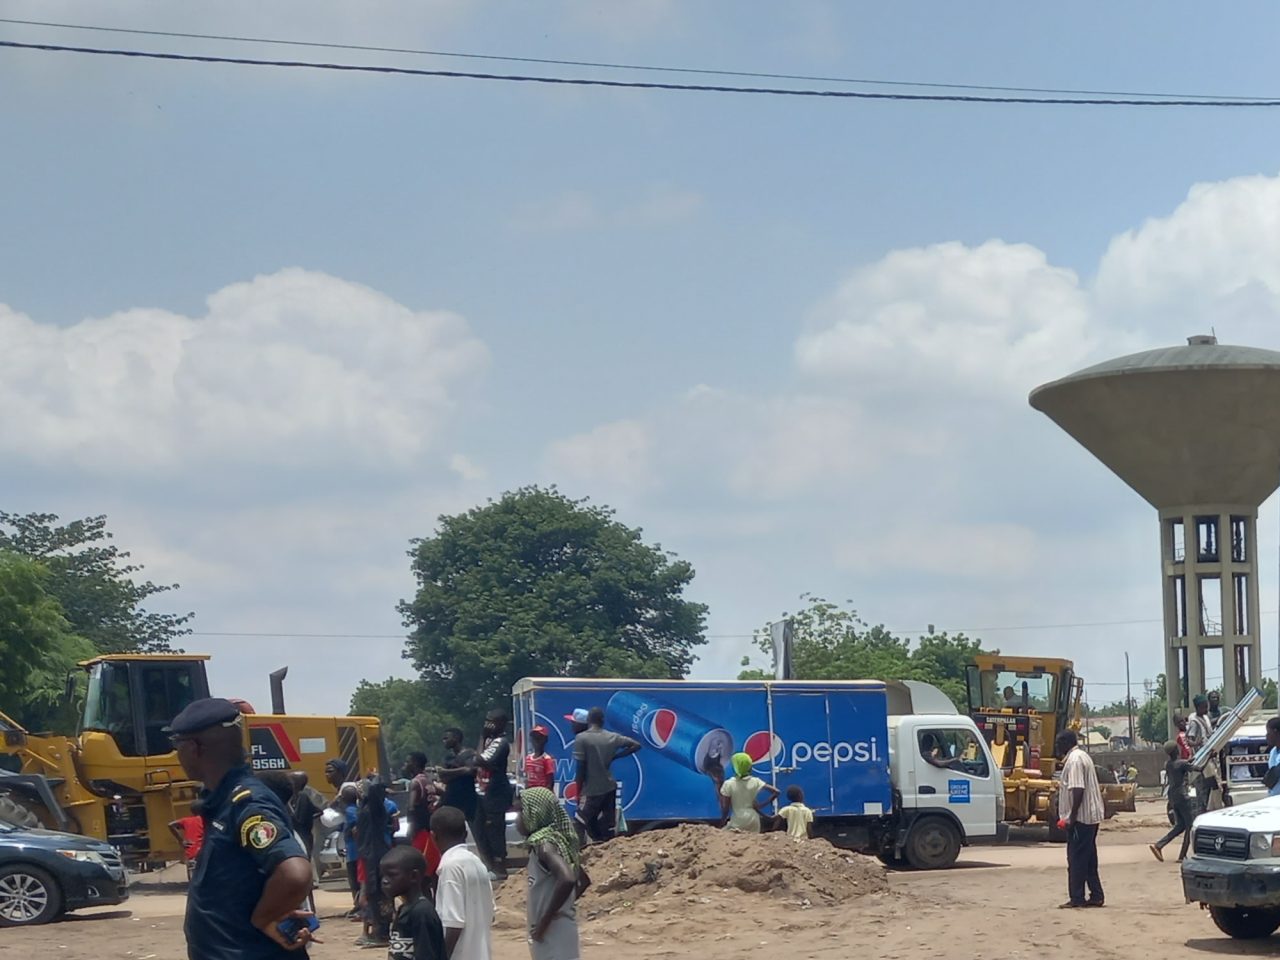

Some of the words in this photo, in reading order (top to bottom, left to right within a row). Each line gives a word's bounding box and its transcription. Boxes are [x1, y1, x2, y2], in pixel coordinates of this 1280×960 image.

[251, 744, 267, 755] FL
[791, 736, 877, 768] pepsi
[252, 758, 285, 769] 956H
